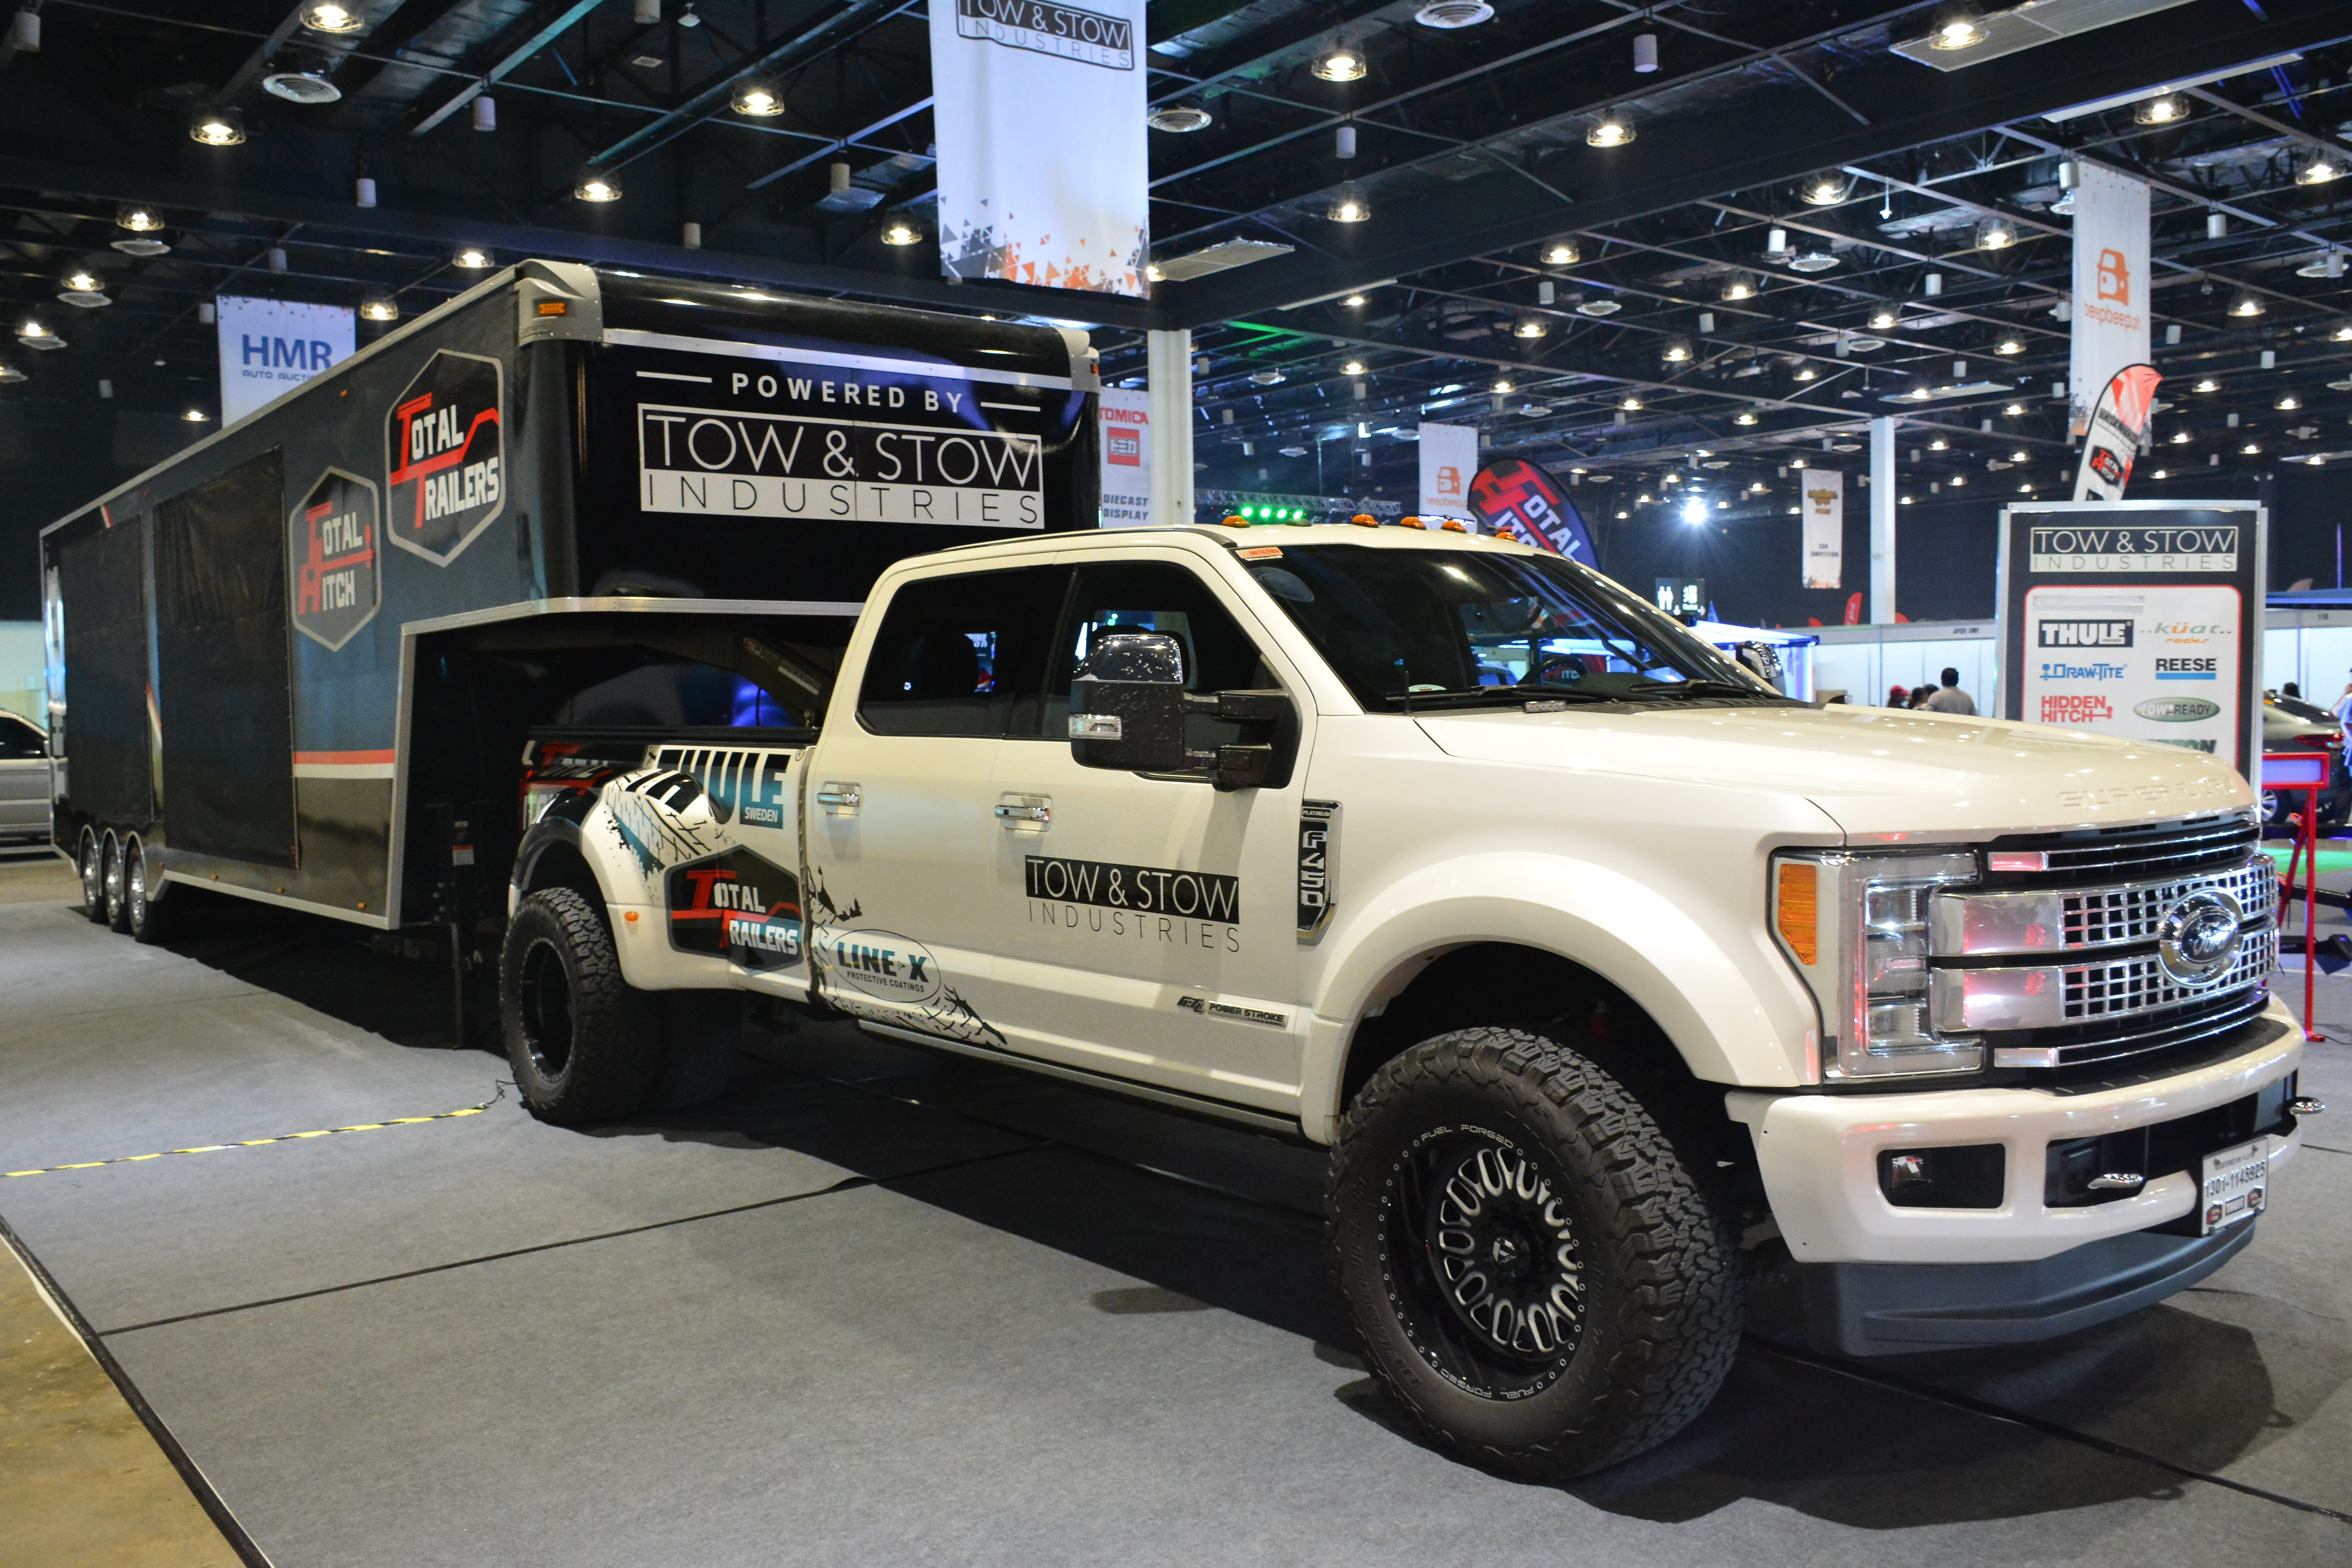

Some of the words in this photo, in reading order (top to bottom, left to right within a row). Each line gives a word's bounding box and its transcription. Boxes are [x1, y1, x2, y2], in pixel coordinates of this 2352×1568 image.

[1032, 5, 1048, 31] &
[1054, 10, 1127, 48] STOW
[961, 18, 1130, 67] INDUSTRIES
[242, 334, 332, 371] HMR
[242, 370, 273, 379] AUTO
[732, 372, 905, 408] POWERED
[925, 392, 962, 413] BY
[1098, 407, 1149, 425] TOMICA
[396, 392, 465, 471] TOTAL
[646, 414, 804, 474] TOW
[822, 430, 860, 477] &
[875, 432, 1035, 487] STOW
[394, 456, 500, 528] TRAILERS
[649, 474, 1038, 524] INDUSTRIES
[1103, 494, 1149, 507] DIECAST
[1103, 508, 1149, 521] DISPLAY
[305, 501, 363, 561] TOTAL
[2035, 530, 2109, 553] TOW
[2116, 531, 2135, 553] &
[2144, 530, 2234, 552] STOW
[2034, 555, 2234, 570] INDUSTRIES
[2041, 623, 2126, 645] THULE
[2156, 658, 2216, 671] REESE
[2041, 695, 2106, 709] HIDDEN
[2174, 704, 2211, 715] READY
[2041, 709, 2093, 722] HITCH
[744, 806, 778, 823] SWEDEN
[687, 870, 766, 913] TOTAL
[1027, 859, 1099, 901] TOW
[1109, 869, 1128, 906] &
[1137, 870, 1238, 920] STOW
[720, 910, 798, 955] TRAILERS
[1029, 900, 1240, 953] INDUSTRIES
[847, 971, 888, 986] PROTECTIVE
[889, 980, 925, 993] COATINGS
[1209, 1003, 1242, 1015] POWER
[1244, 1009, 1284, 1023] STROKE
[1421, 1125, 1452, 1142] FUEL
[1461, 1124, 1514, 1149] FORGED
[1441, 1368, 1492, 1398] FORGED
[1500, 1386, 1534, 1399] FUEL
